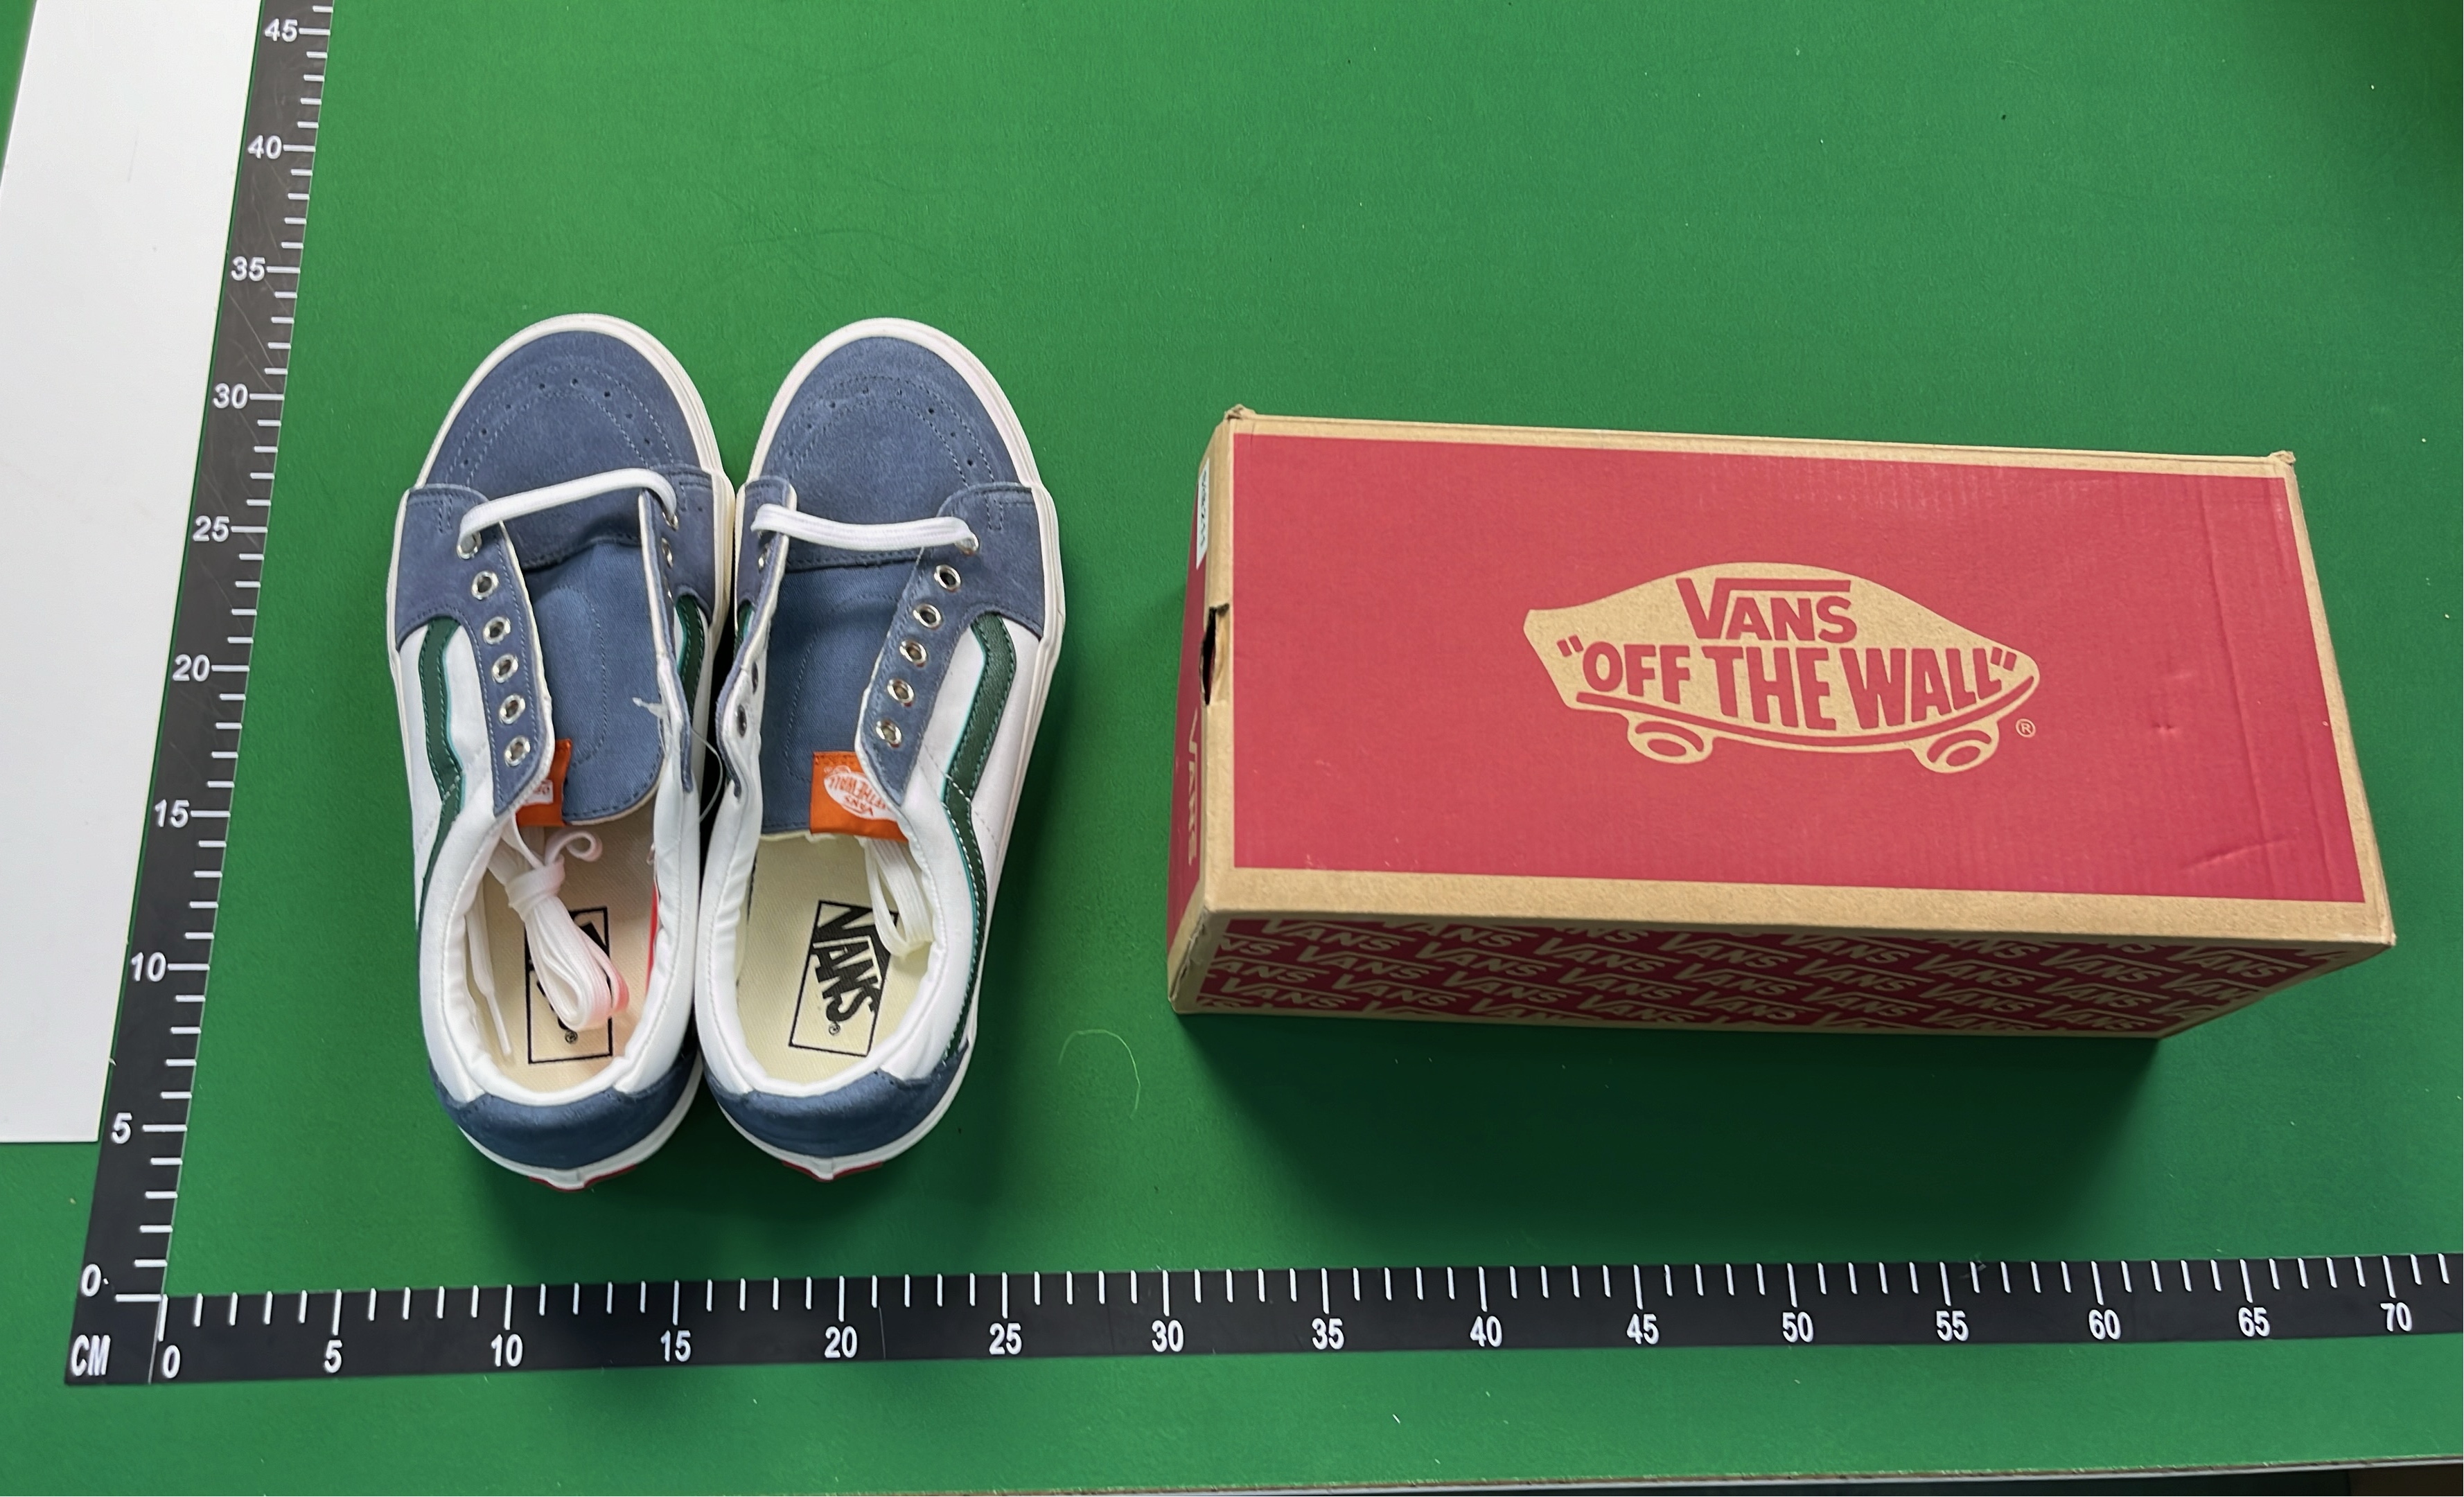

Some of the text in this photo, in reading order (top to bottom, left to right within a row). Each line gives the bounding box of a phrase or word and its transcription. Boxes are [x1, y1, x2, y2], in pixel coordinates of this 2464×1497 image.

[264, 18, 298, 42] 45
[247, 134, 282, 159] 40
[231, 256, 266, 281] 35
[213, 382, 248, 409] 30
[192, 515, 230, 542] 25
[1675, 577, 1858, 644] VANS
[172, 654, 210, 682] 20
[1556, 635, 1692, 705] "OFF
[1700, 645, 1837, 731] THE
[1840, 646, 2018, 730] WALL"
[155, 799, 190, 828] 15
[131, 952, 166, 982] 10
[810, 905, 892, 1022] VANS
[1296, 945, 1446, 980] VANS
[1415, 941, 1564, 977] VANS
[1532, 937, 1683, 973] VANS
[1657, 933, 1808, 968] VANS
[1208, 955, 1330, 983] ANS
[1331, 973, 1472, 1006] VANS
[1442, 970, 1583, 1004] VANS
[1556, 966, 1700, 1000] VANS
[1672, 962, 1815, 996] VANS
[1793, 958, 1936, 992] VANS
[1911, 953, 2057, 988] VANS
[2039, 948, 2183, 983] VANS
[1220, 976, 1361, 1009] VANS
[1689, 990, 1824, 1020] VANS
[1800, 986, 1937, 1016] VANS
[1917, 982, 2055, 1013] VANS
[2034, 977, 2170, 1009] VANS
[111, 1113, 132, 1144] 5
[80, 1264, 101, 1297] 0
[71, 1334, 111, 1376] CM
[162, 1302, 2413, 1379] 0 5 10 15 20 25 30 35 40 45 50 55 60 65 70
